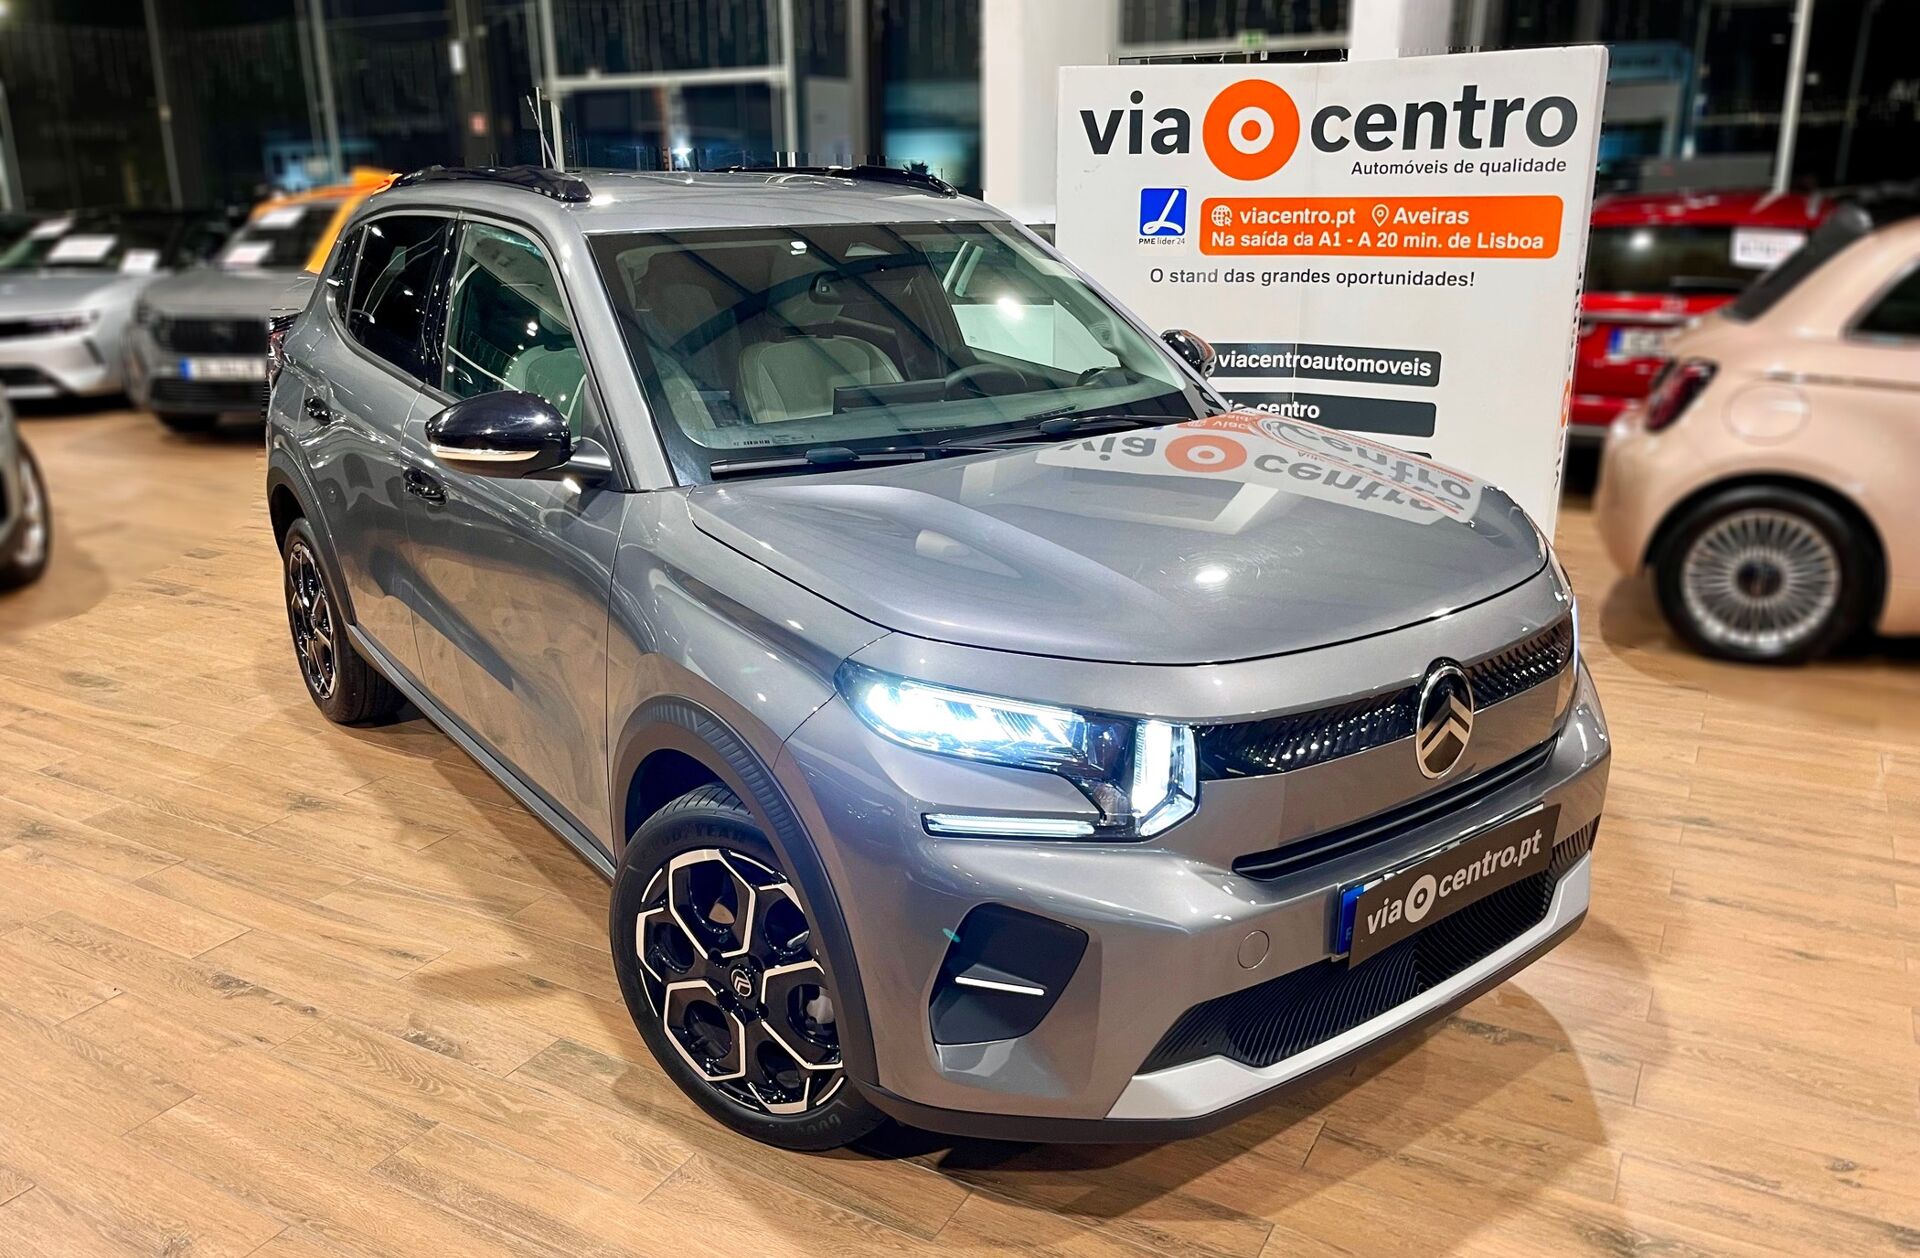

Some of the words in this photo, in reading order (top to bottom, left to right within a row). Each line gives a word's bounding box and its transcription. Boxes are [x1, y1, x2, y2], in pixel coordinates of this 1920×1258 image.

[1080, 90, 1191, 155] via
[1311, 85, 1578, 153] centro
[1351, 160, 1448, 175] Automóveis
[1454, 160, 1474, 174] de
[1480, 158, 1567, 176] qualidade
[1239, 207, 1356, 228] viacentro.pt
[1393, 207, 1470, 225] Aveiras
[1211, 232, 1235, 247] Na
[1240, 231, 1288, 247] saída
[1293, 231, 1314, 247] da
[1318, 231, 1341, 247] A1
[1357, 232, 1371, 247] A
[1376, 232, 1398, 248] 20
[1403, 232, 1442, 248] min.
[1447, 232, 1471, 248] de
[1477, 232, 1544, 249] Lisboa
[1150, 268, 1163, 283] O
[1169, 269, 1218, 283] stand
[1224, 268, 1255, 283] das
[1261, 268, 1330, 286] grandes
[1336, 270, 1475, 288] oportunidades!
[1218, 350, 1432, 377] viacentroautomoveis
[1366, 894, 1402, 935] via
[1438, 828, 1543, 898] centro.pt
